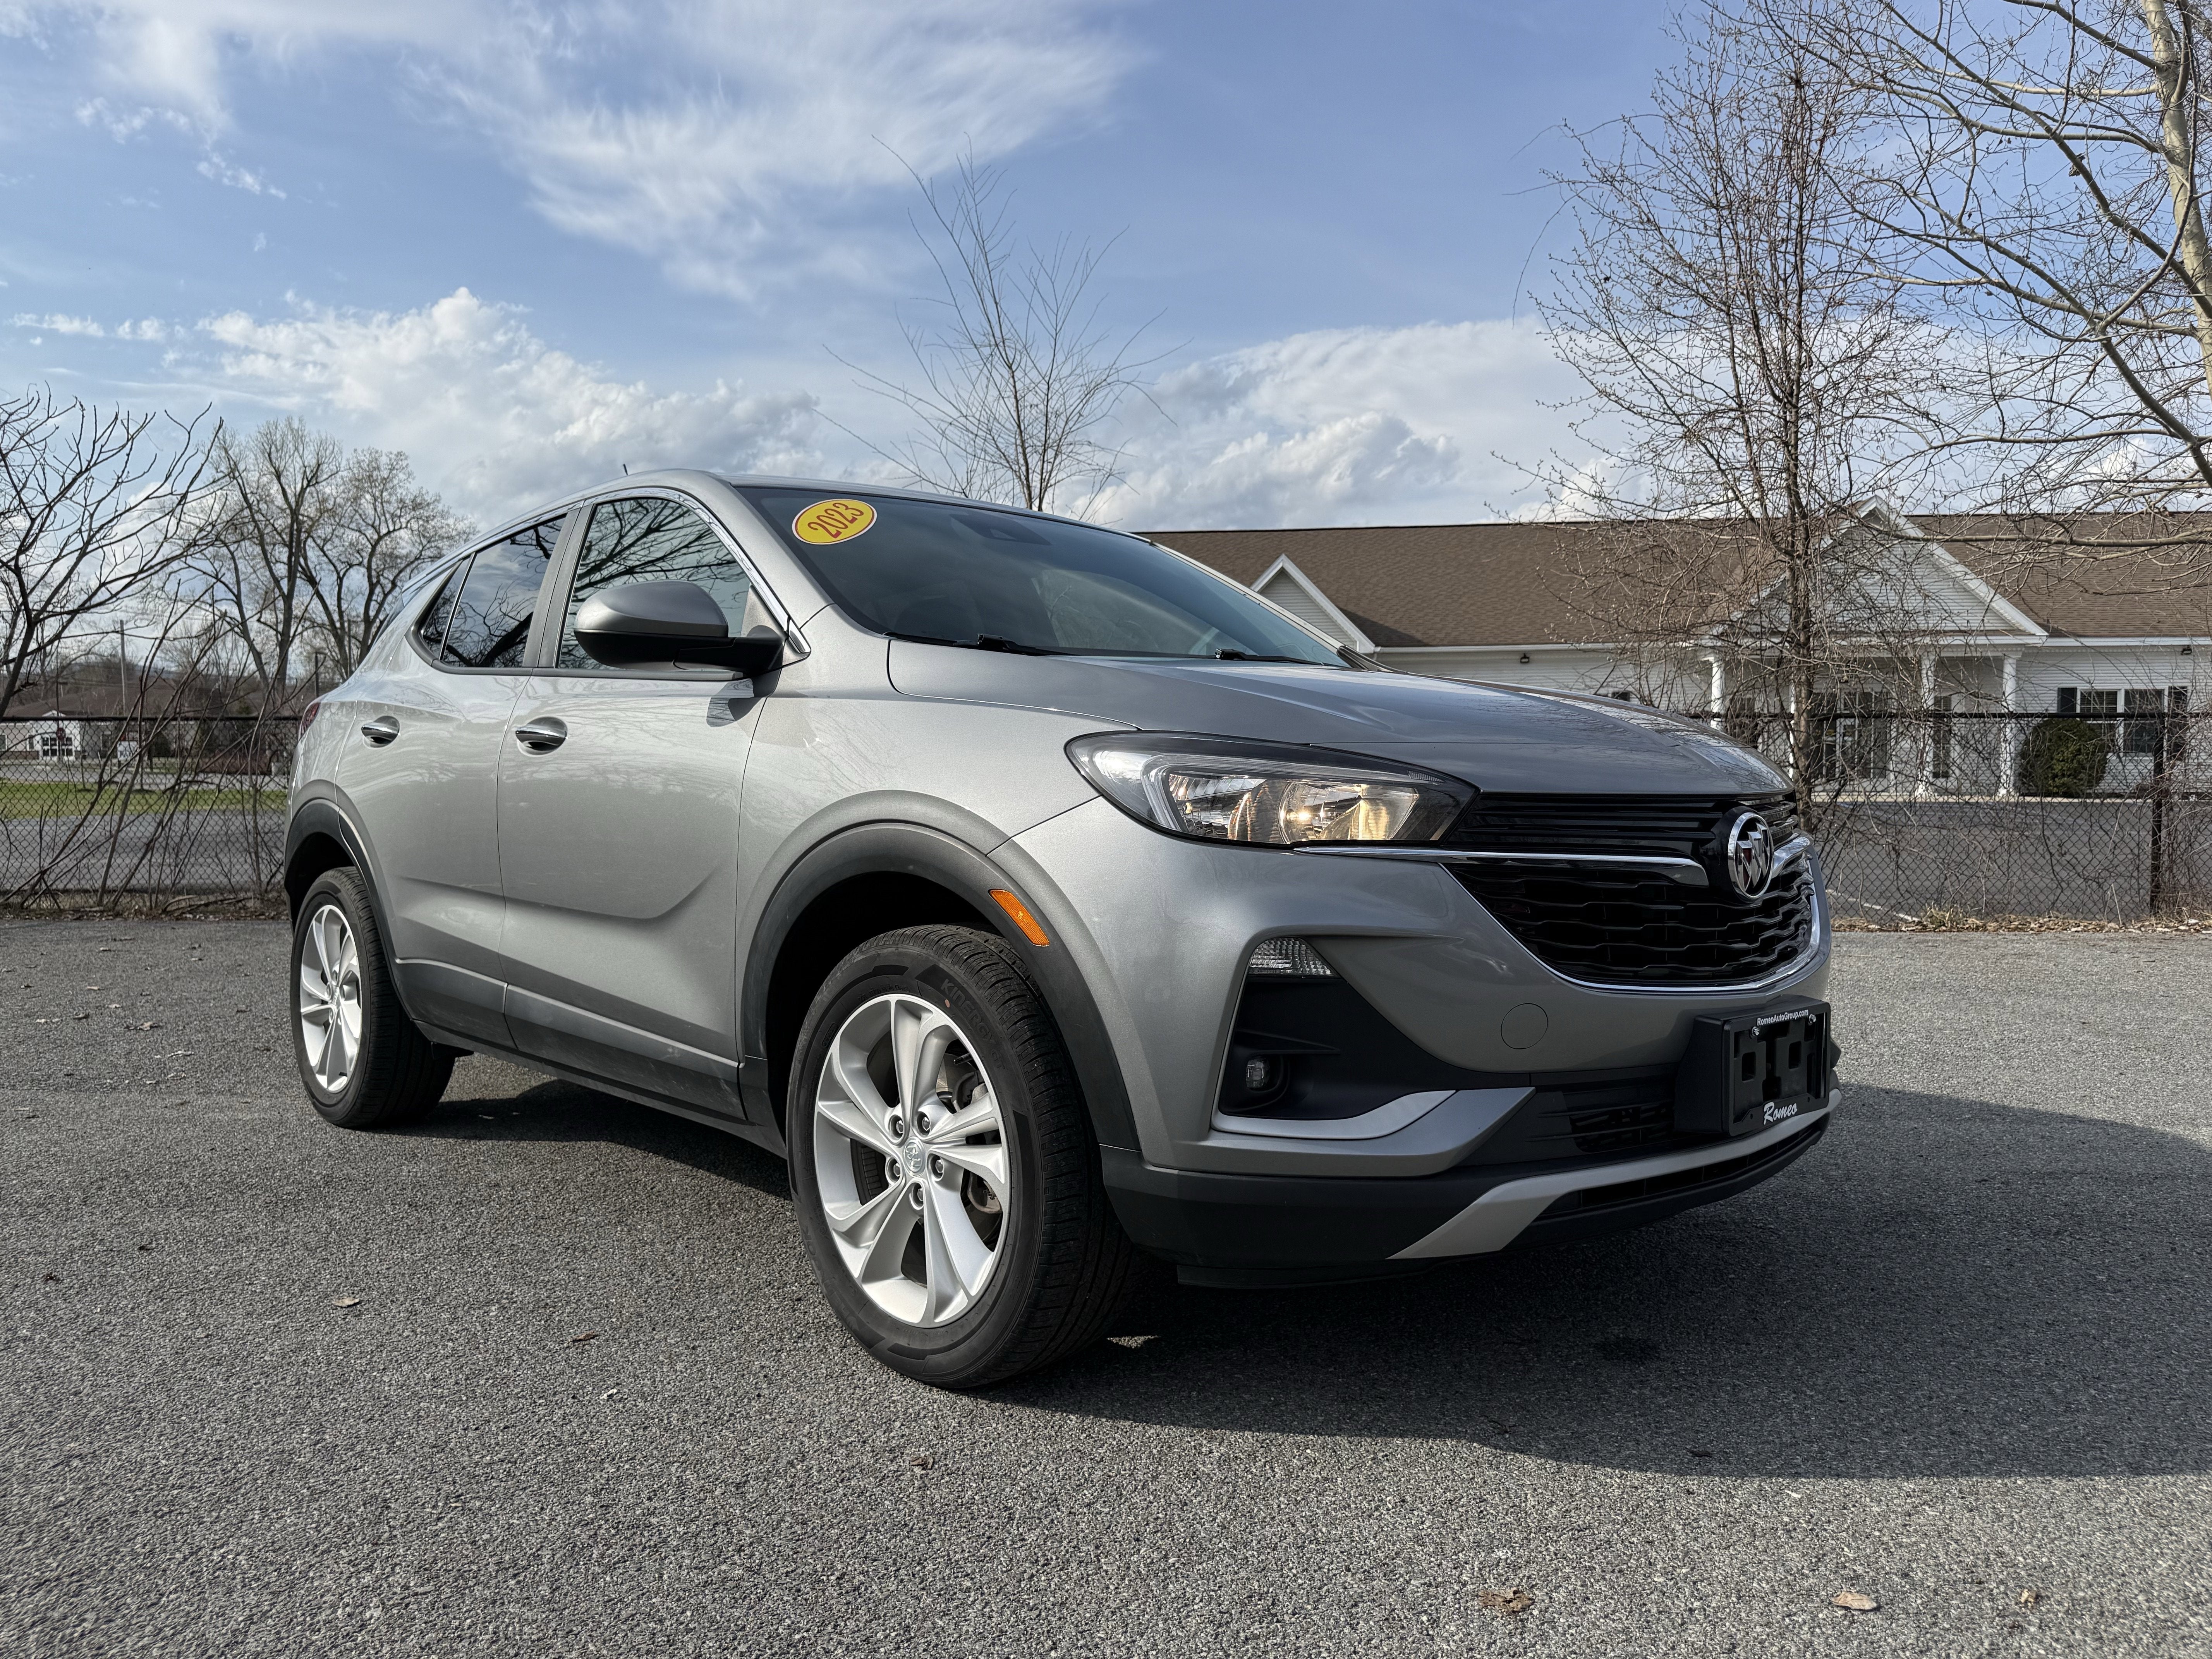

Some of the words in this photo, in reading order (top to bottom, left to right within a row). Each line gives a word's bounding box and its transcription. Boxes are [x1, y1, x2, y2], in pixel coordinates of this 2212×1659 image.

[807, 503, 864, 538] 2023
[1757, 1009, 1809, 1026] RomeoAutoGroup.com
[1764, 1101, 1798, 1125] Romeo
